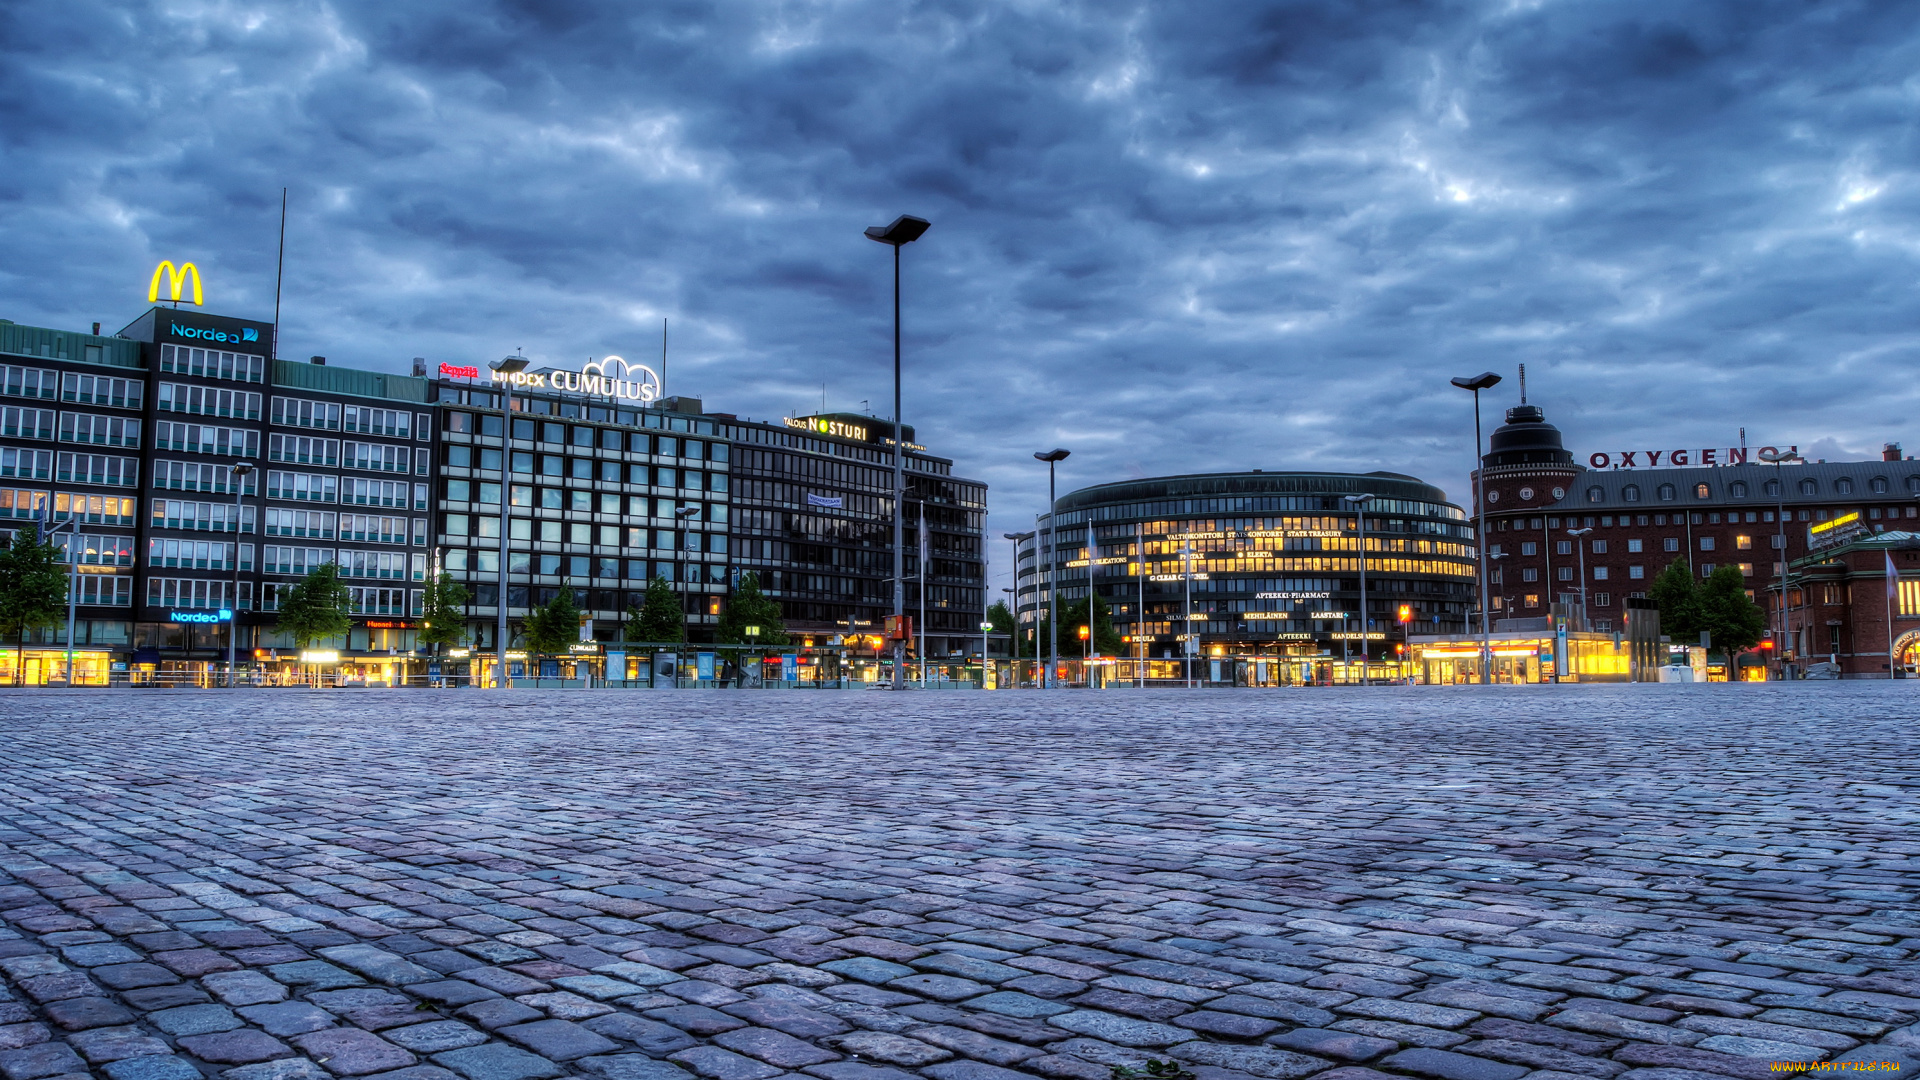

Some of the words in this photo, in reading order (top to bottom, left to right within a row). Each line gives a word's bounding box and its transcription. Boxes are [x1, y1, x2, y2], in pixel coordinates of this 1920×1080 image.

[171, 323, 240, 344] Nordea
[440, 362, 478, 378] Seppälä
[551, 370, 653, 401] CUMULUS
[783, 417, 807, 429] TALOUS
[1167, 532, 1224, 541] VALTIOKONTTORI
[1178, 573, 1209, 581] CNEL
[171, 611, 218, 623] Nordea
[1244, 611, 1288, 620] MEHILÄINEN
